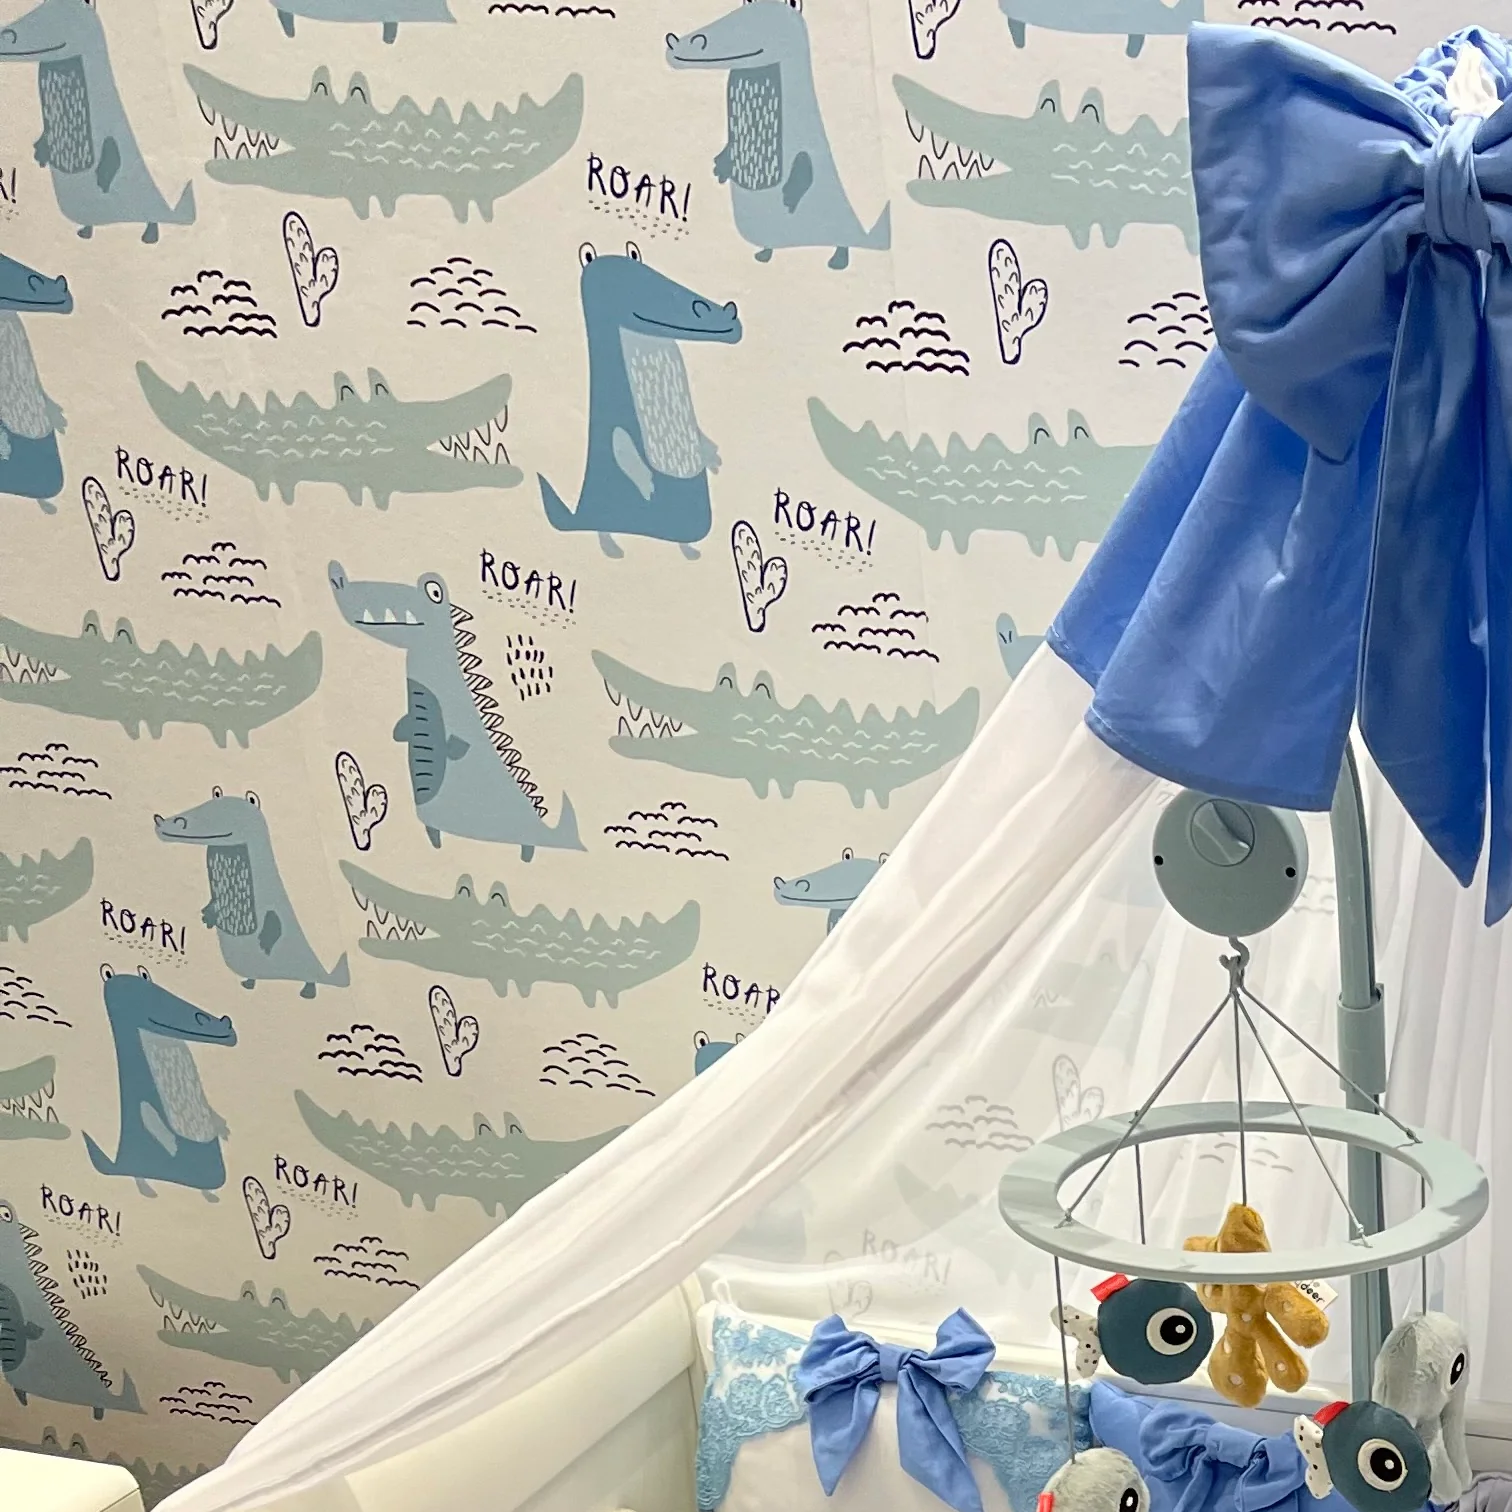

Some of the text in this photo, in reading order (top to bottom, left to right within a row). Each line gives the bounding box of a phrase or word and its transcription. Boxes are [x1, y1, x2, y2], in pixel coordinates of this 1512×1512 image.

[587, 153, 691, 222] ROAR!
[115, 445, 207, 508] ROAR!
[774, 487, 876, 556] ROAR!
[480, 549, 577, 614] ROAR!
[99, 898, 186, 955] ROAR!
[40, 1184, 121, 1234] ROAR!
[274, 1154, 358, 1209] ROAR!
